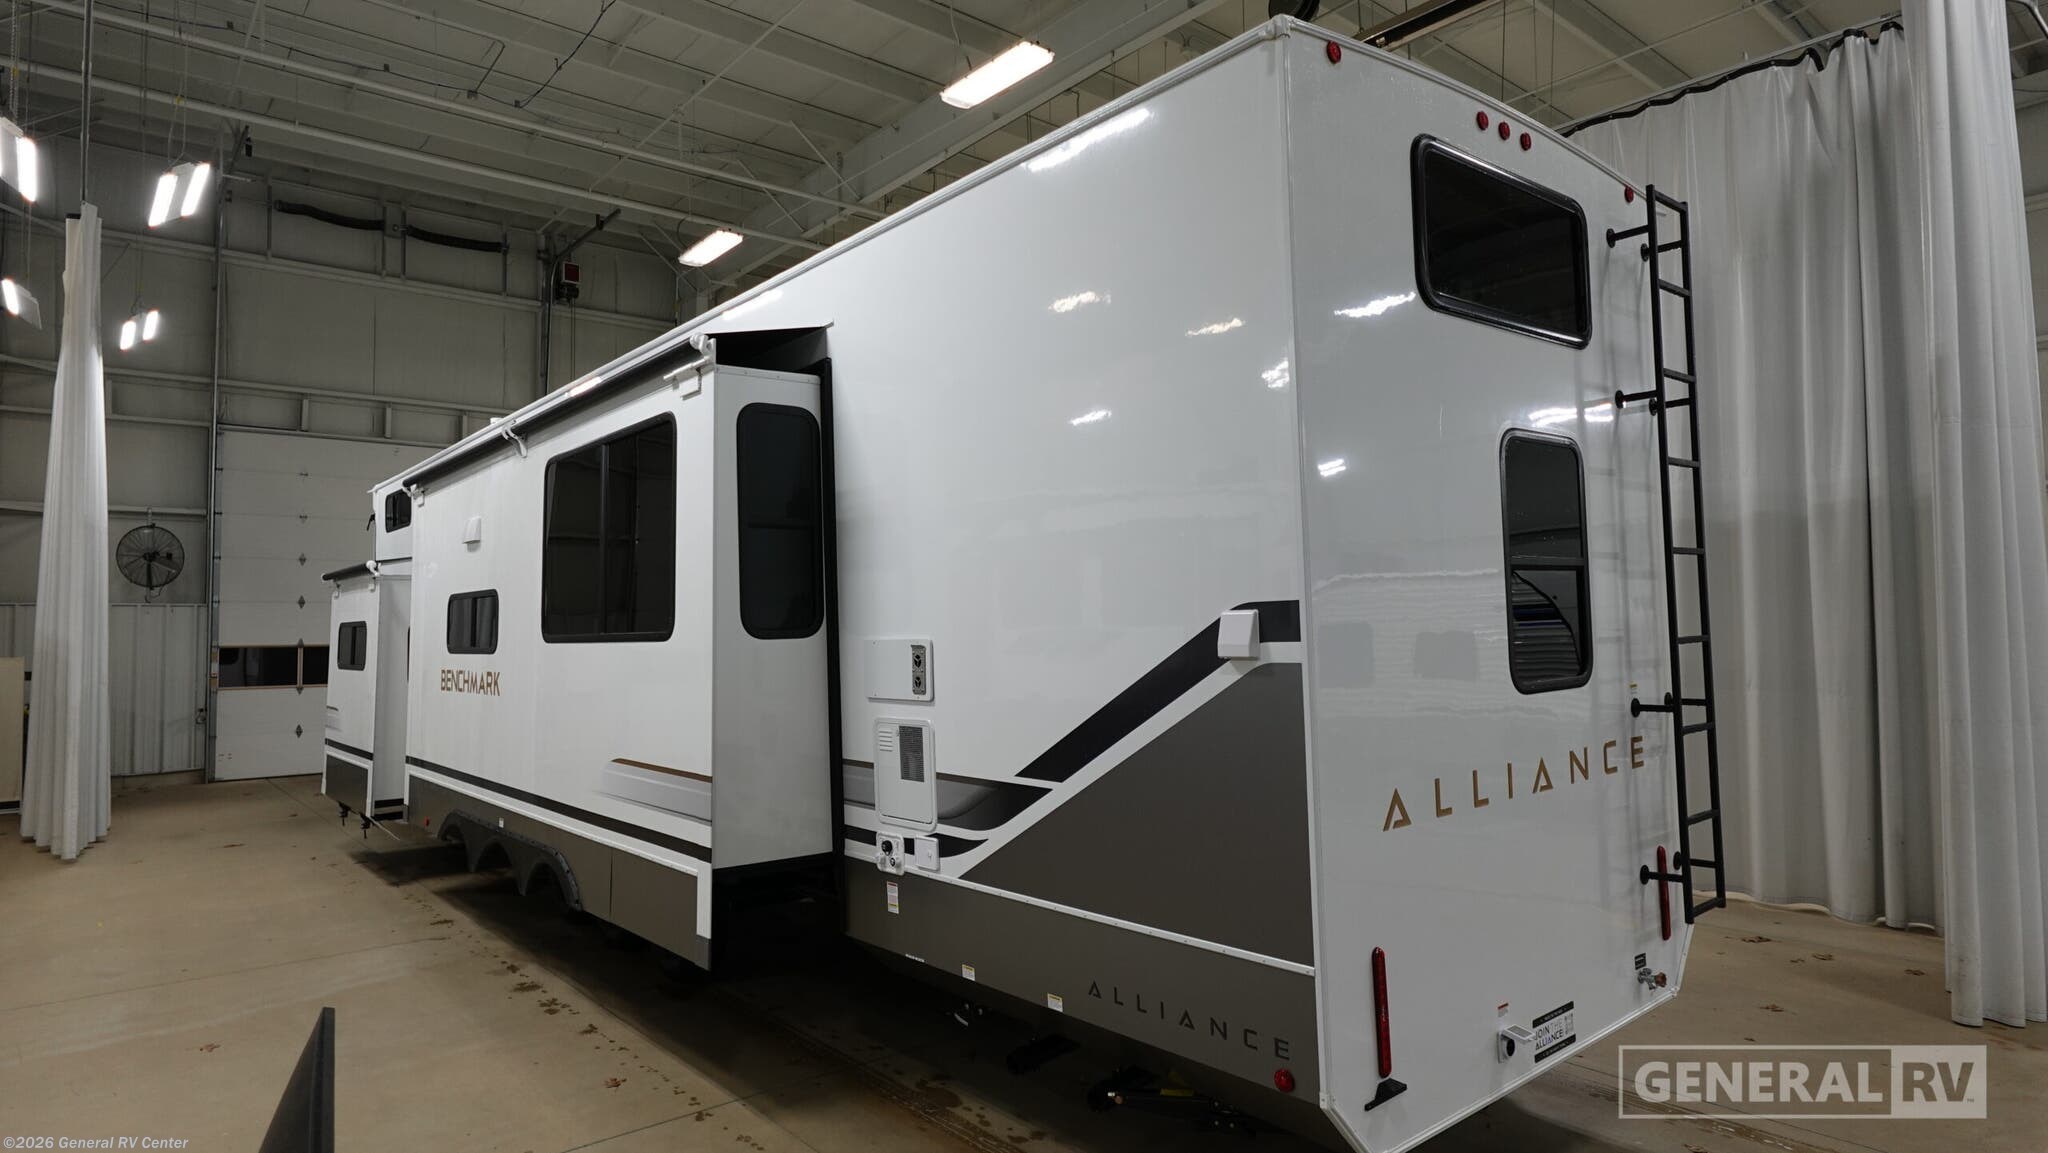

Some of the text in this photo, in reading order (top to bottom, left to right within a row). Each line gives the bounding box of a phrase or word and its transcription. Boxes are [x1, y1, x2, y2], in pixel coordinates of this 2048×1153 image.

[440, 669, 501, 697] BENCHMARK
[1382, 735, 1645, 833] ALLIANCE
[1088, 980, 1291, 1061] ALLIANCE
[1534, 1025, 1550, 1041] JOIN
[1535, 1029, 1564, 1051] ALLIANCE
